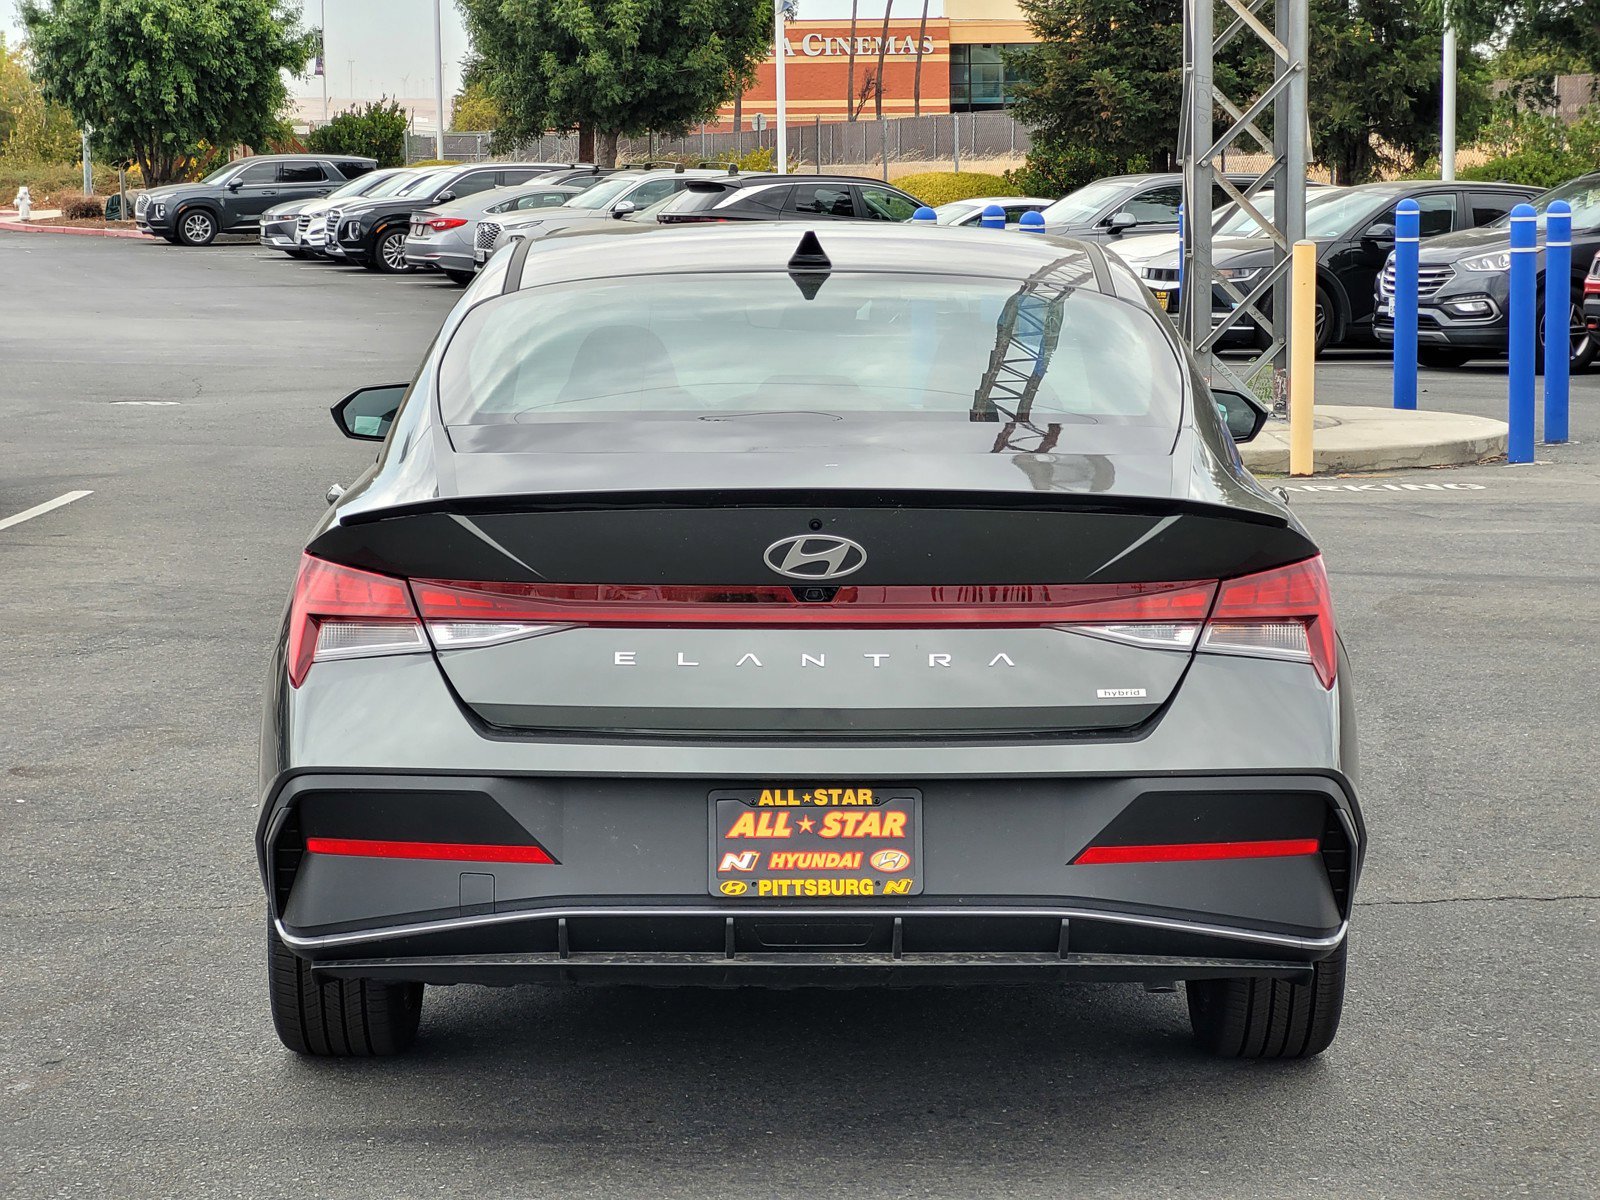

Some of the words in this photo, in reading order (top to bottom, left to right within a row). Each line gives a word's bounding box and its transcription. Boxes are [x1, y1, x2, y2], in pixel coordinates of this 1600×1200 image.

[802, 33, 934, 56] CINEMAS
[614, 651, 1016, 668] ELANTRA
[1103, 689, 1141, 697] hybrid
[758, 789, 800, 806] ALL
[814, 789, 873, 806] STAR
[725, 811, 793, 839] ALL
[818, 811, 907, 839] STAR
[768, 852, 864, 870] HYUNDAI
[758, 879, 874, 896] PITTSBURG
